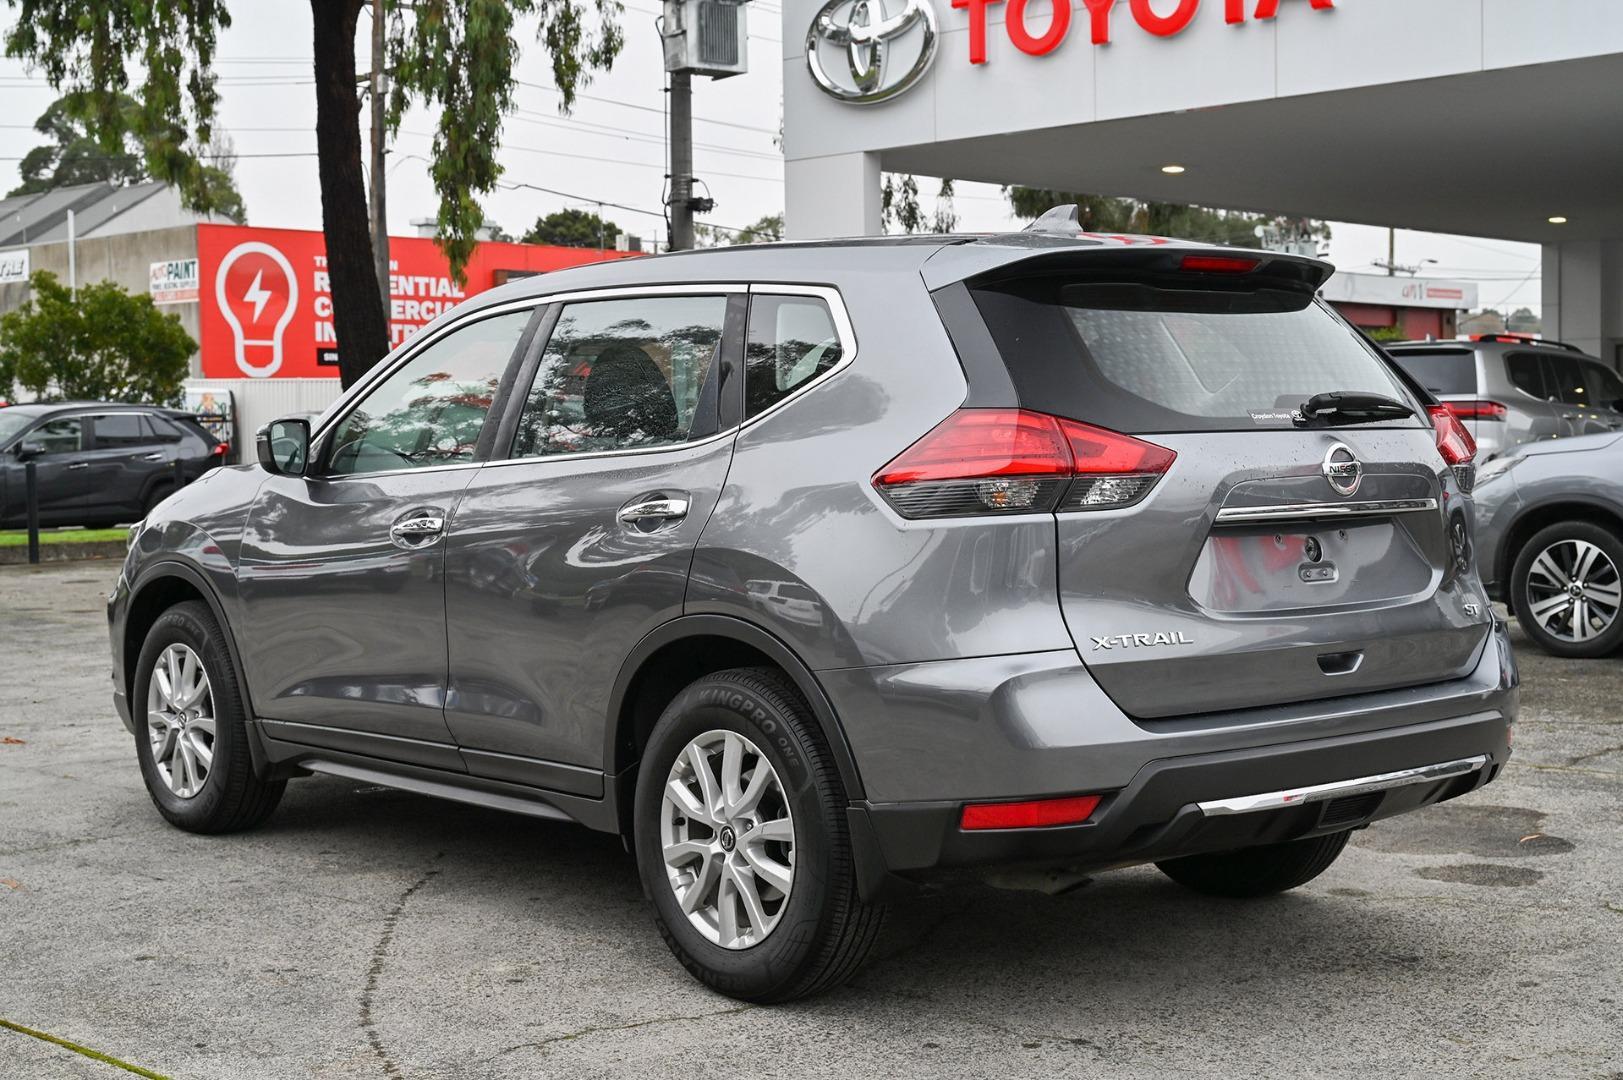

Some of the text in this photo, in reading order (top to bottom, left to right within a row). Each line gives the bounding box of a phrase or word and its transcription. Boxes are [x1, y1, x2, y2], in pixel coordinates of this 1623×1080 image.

[951, 0, 1335, 65] TOYO
[167, 260, 196, 280] PAINT
[314, 271, 465, 298] RENTIAL
[1463, 604, 1479, 616] ST
[1090, 631, 1194, 650] X-TRAIL
[699, 689, 800, 769] KINGPRO ONE
